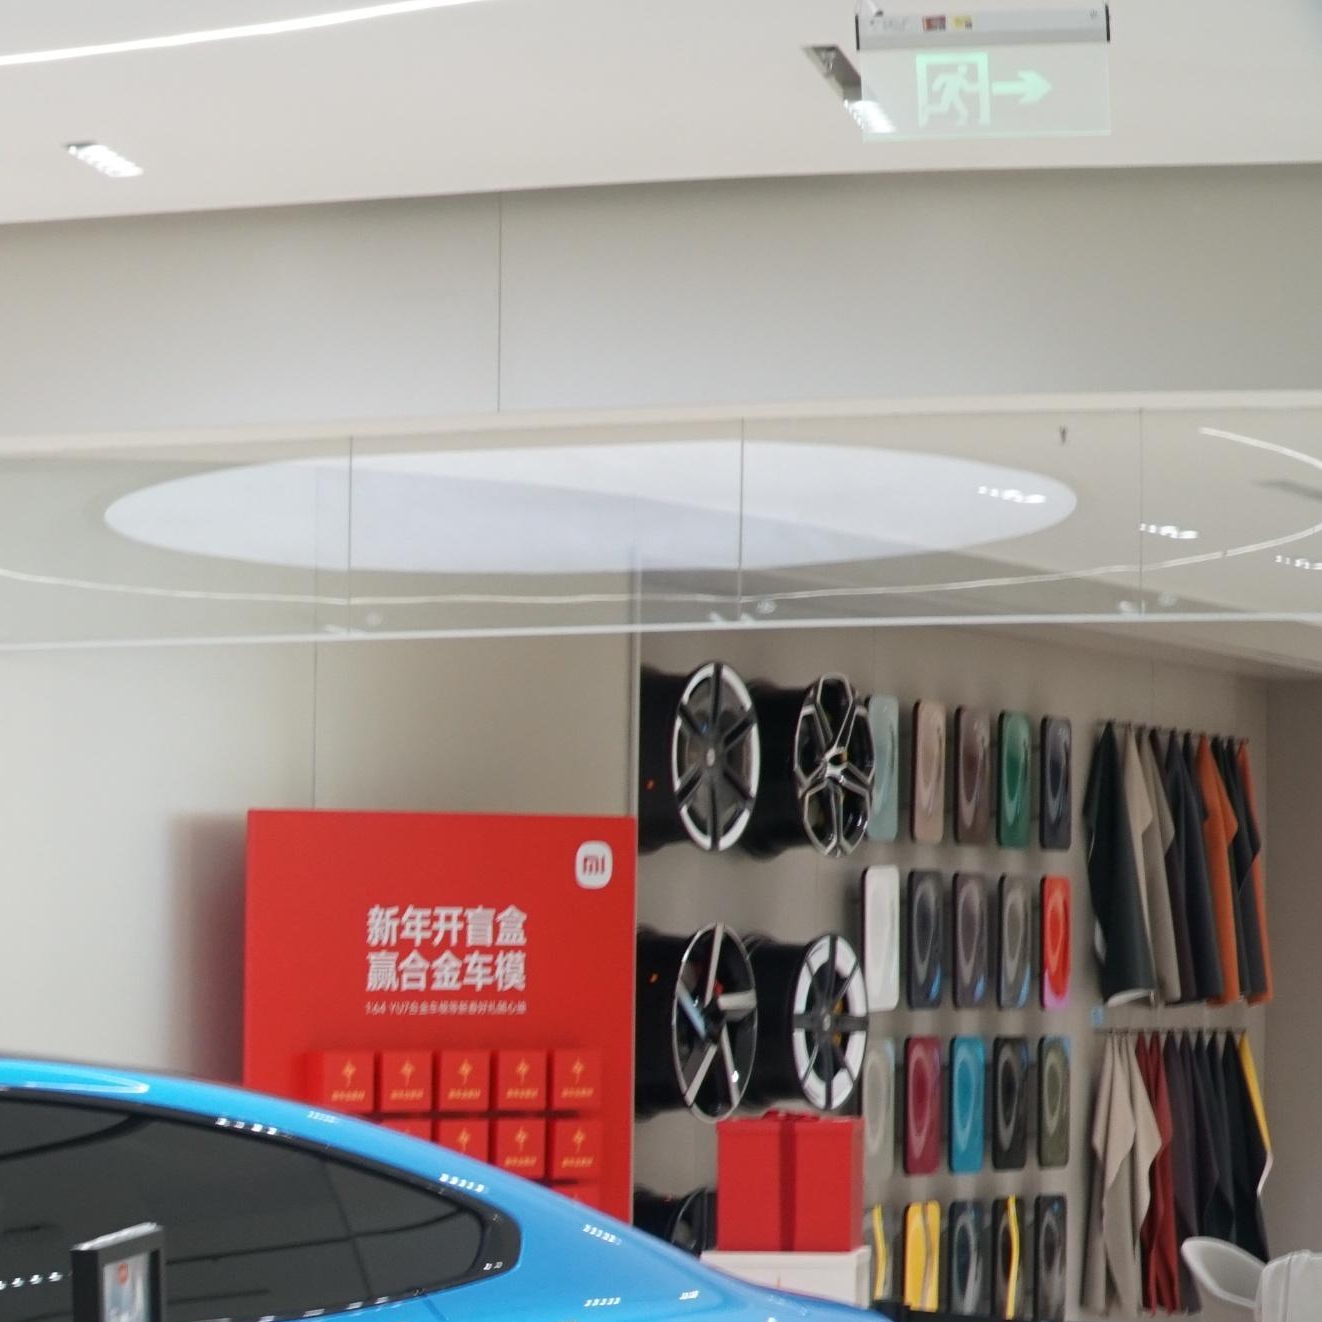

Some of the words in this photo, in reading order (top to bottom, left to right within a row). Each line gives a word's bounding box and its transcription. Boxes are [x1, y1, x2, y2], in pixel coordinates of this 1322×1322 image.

[366, 905, 528, 947] 新年开盲盒
[365, 951, 527, 992] 赢合金车模
